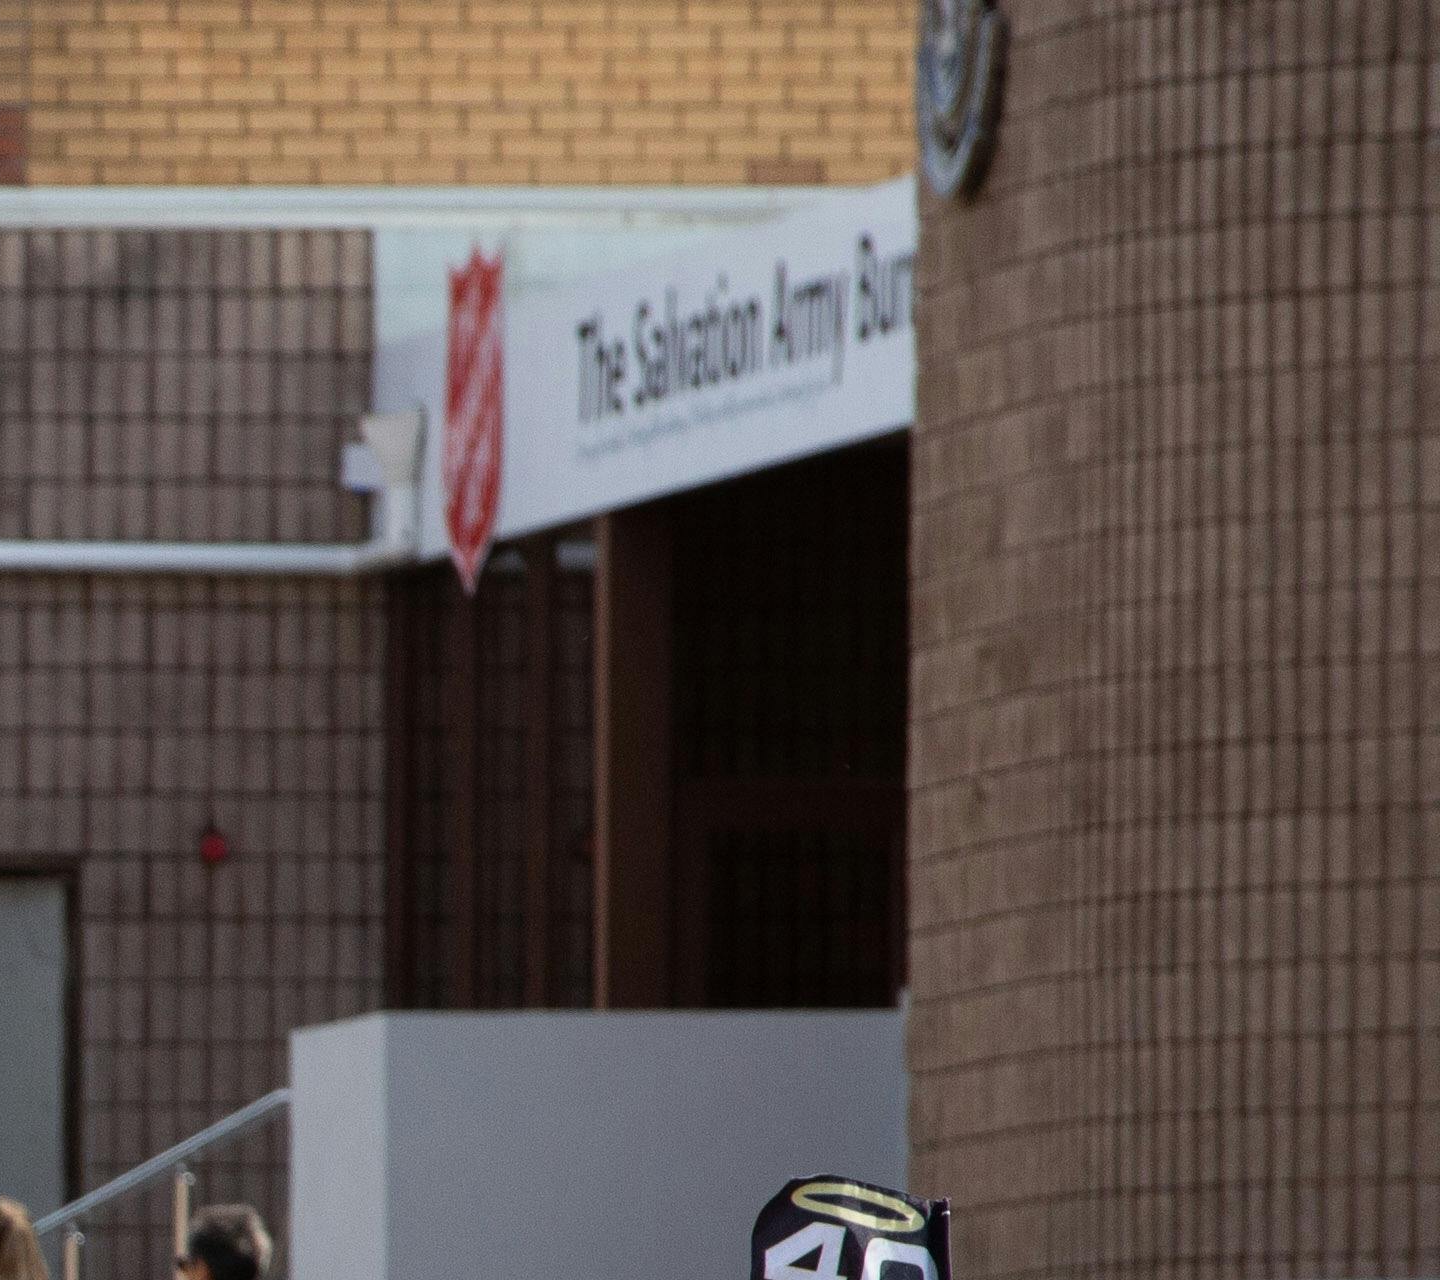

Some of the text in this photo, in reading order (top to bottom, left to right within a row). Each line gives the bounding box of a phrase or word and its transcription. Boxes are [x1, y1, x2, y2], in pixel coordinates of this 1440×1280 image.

[577, 312, 626, 424] The
[633, 272, 764, 406] Salvation
[767, 257, 847, 385] Army
